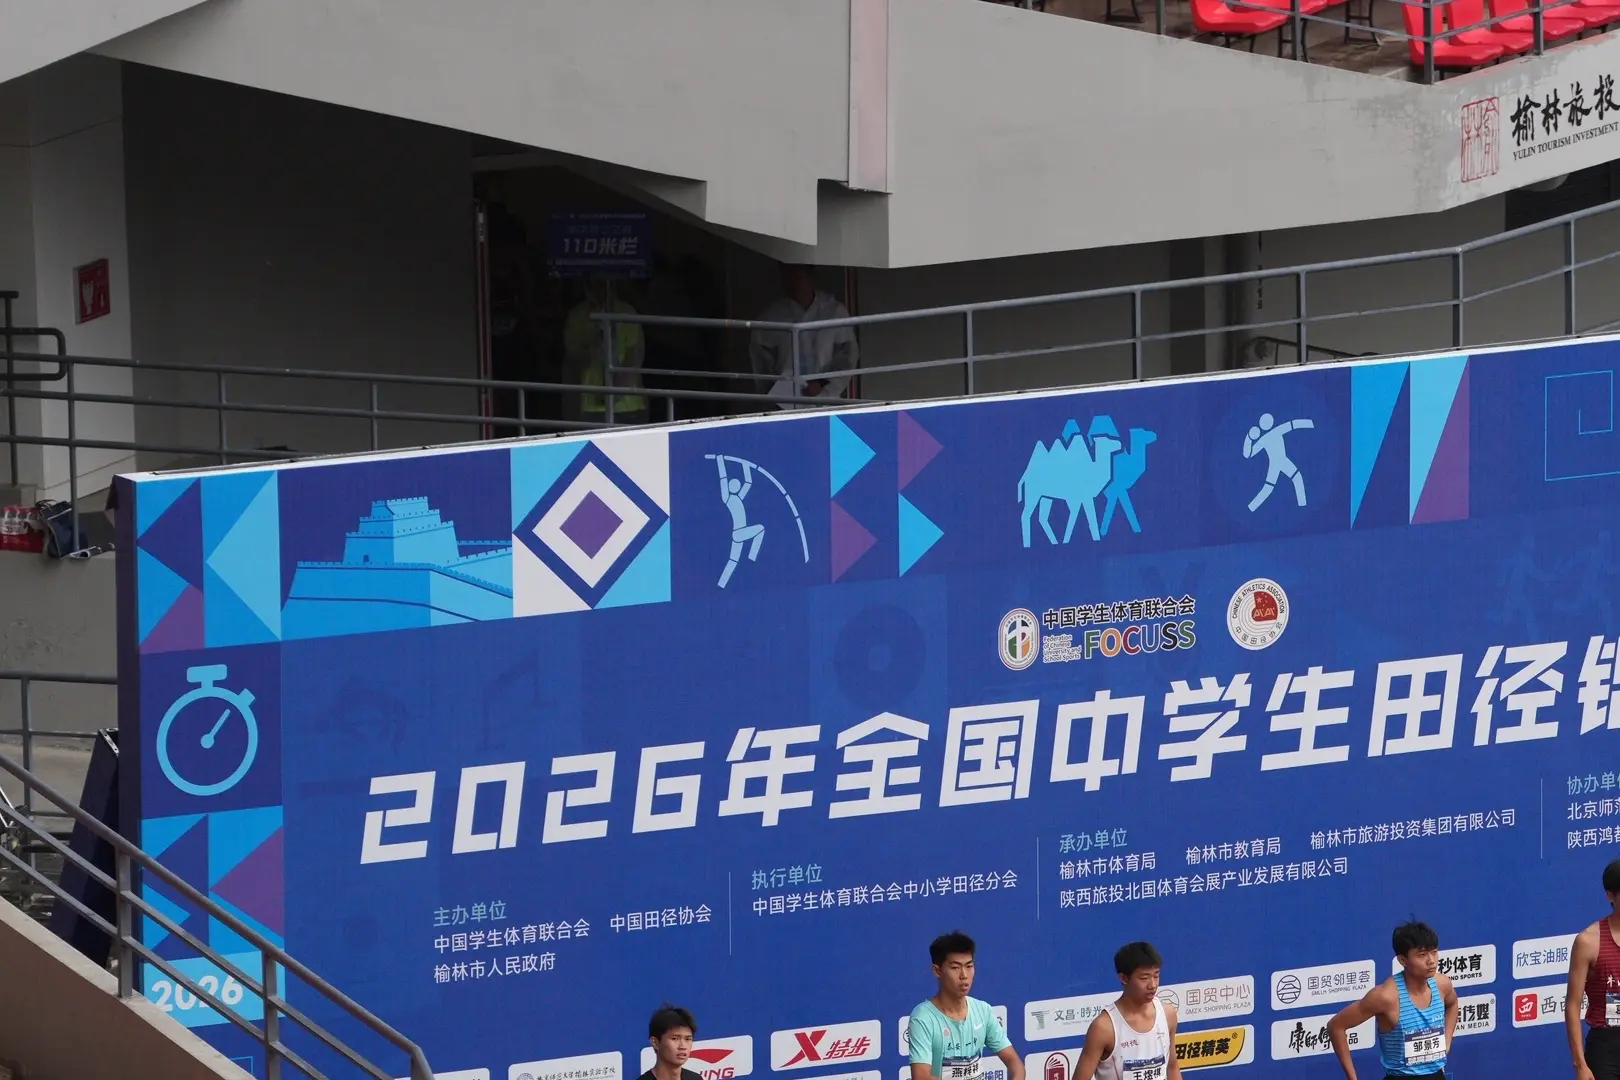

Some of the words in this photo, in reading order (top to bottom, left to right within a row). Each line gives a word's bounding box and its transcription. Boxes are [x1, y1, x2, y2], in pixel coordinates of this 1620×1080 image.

[1513, 145, 1536, 161] YULIN
[1538, 136, 1571, 156] TOURISM
[1573, 122, 1619, 143] INVESTMENT
[564, 236, 638, 256] 110米栏
[1043, 594, 1195, 630] 中国学生体育联合会
[1232, 596, 1243, 619] CHINESE
[1242, 583, 1265, 597] ATHLETICS
[1267, 585, 1285, 613] ASSOCIATION
[1043, 634, 1072, 643] Federation
[1084, 620, 1196, 659] FOCUSS
[1043, 647, 1070, 656] University
[1043, 654, 1062, 663] School
[1063, 653, 1081, 662] Sports
[1059, 828, 1128, 854] 承办单位
[1059, 852, 1156, 880] 榆林市体育局
[1185, 837, 1281, 866] 榆林市教育局
[1310, 808, 1515, 850] 榆林市旅游投资集团有限公司
[751, 864, 823, 890] 执行单位
[1059, 856, 1348, 909] 陕西旅投北国体育会展产业发展有限公司
[752, 869, 1018, 916] 中国学生体育联合会中小学田径分会
[433, 900, 507, 927] 主办单位
[434, 918, 590, 954] 中国学生体育联合会
[609, 904, 712, 933] 中国田径协会
[434, 952, 556, 984] 榆林市人民政府
[1516, 947, 1568, 967] 欣宝油服
[1307, 970, 1371, 990] 国贸邻里荟
[1460, 972, 1483, 980] SPORTS
[151, 974, 243, 1012] 2026
[1185, 984, 1251, 1005] 国贸中心
[1328, 985, 1351, 994] SHOPPING
[1352, 983, 1367, 991] PLAZA
[1204, 1004, 1232, 1013] SHOPPING
[1233, 1001, 1251, 1009] PLAZA
[1467, 1021, 1490, 1029] MEDIA
[823, 1036, 871, 1060] 特步
[1174, 1037, 1231, 1060] 田径精英
[1413, 1037, 1440, 1053] 邹景芳
